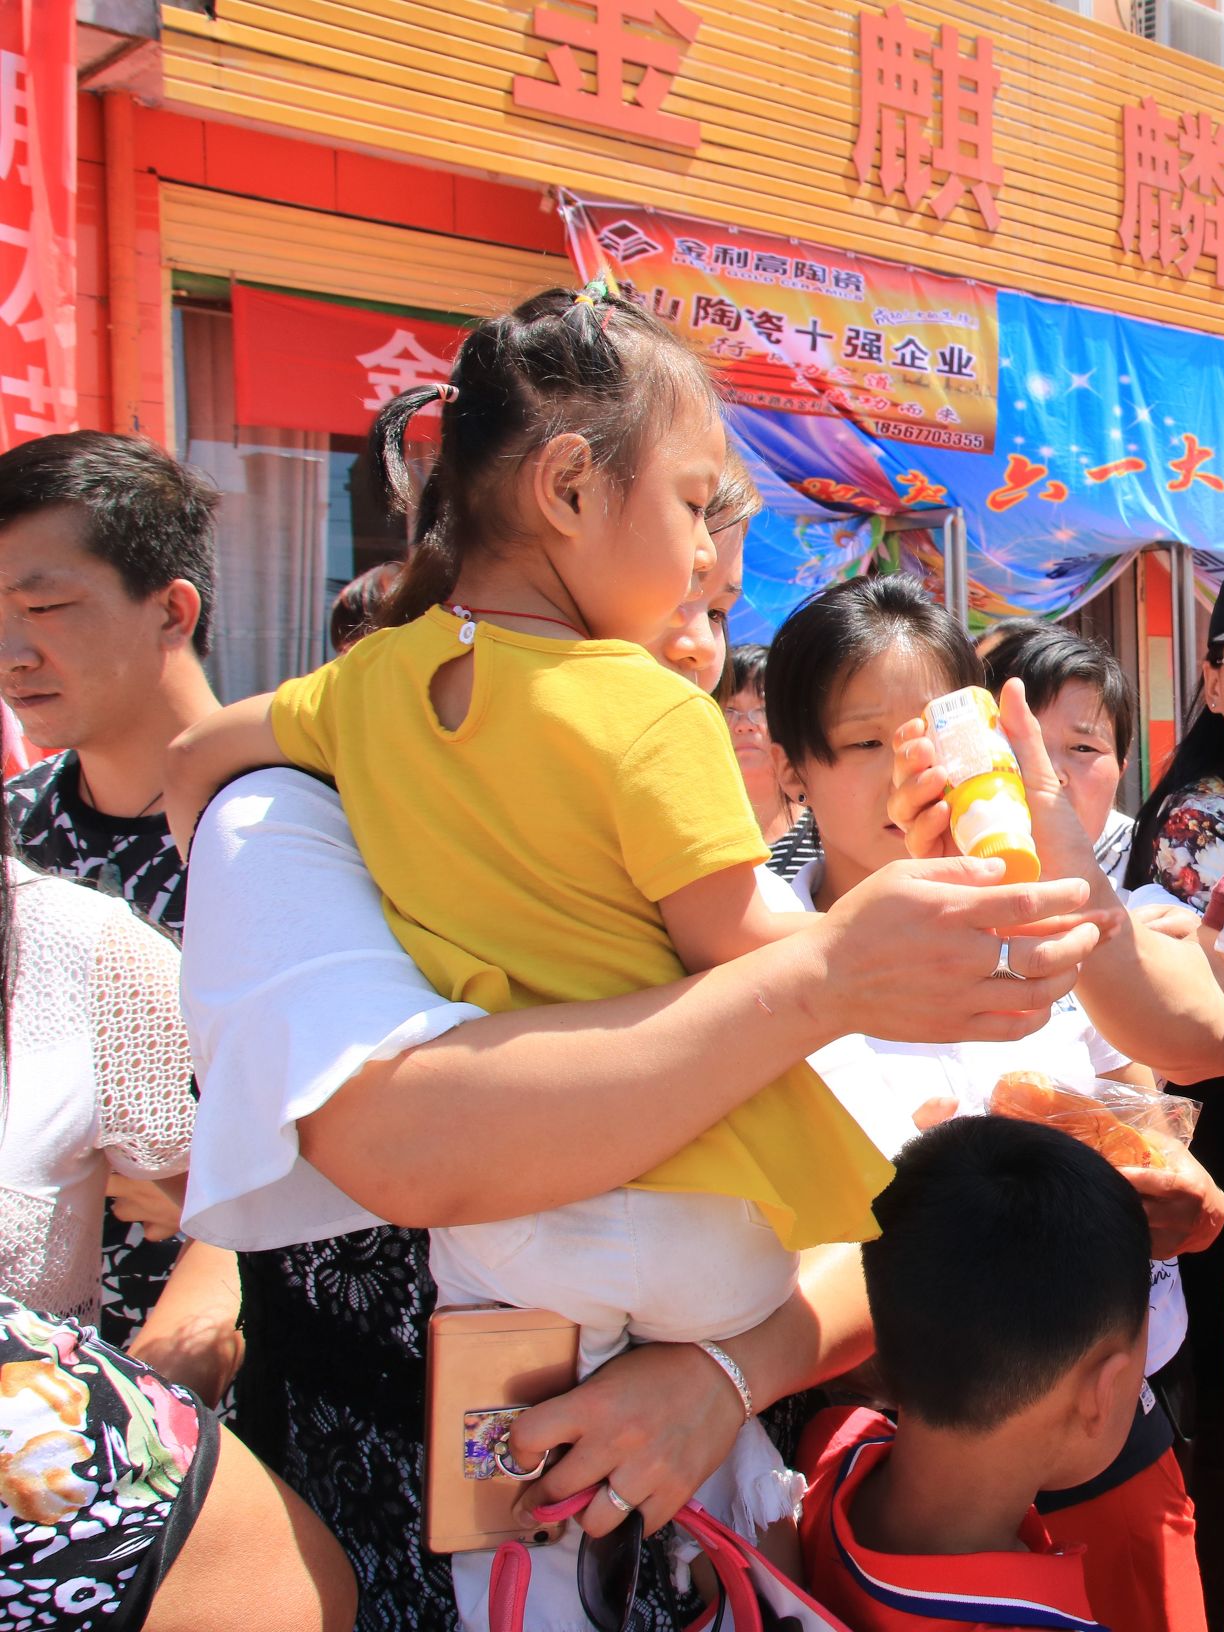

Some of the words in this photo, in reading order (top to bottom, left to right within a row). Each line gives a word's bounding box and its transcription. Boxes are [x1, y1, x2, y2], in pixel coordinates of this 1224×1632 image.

[676, 237, 864, 293] 金利高陶瓷
[874, 419, 984, 450] 18567703355
